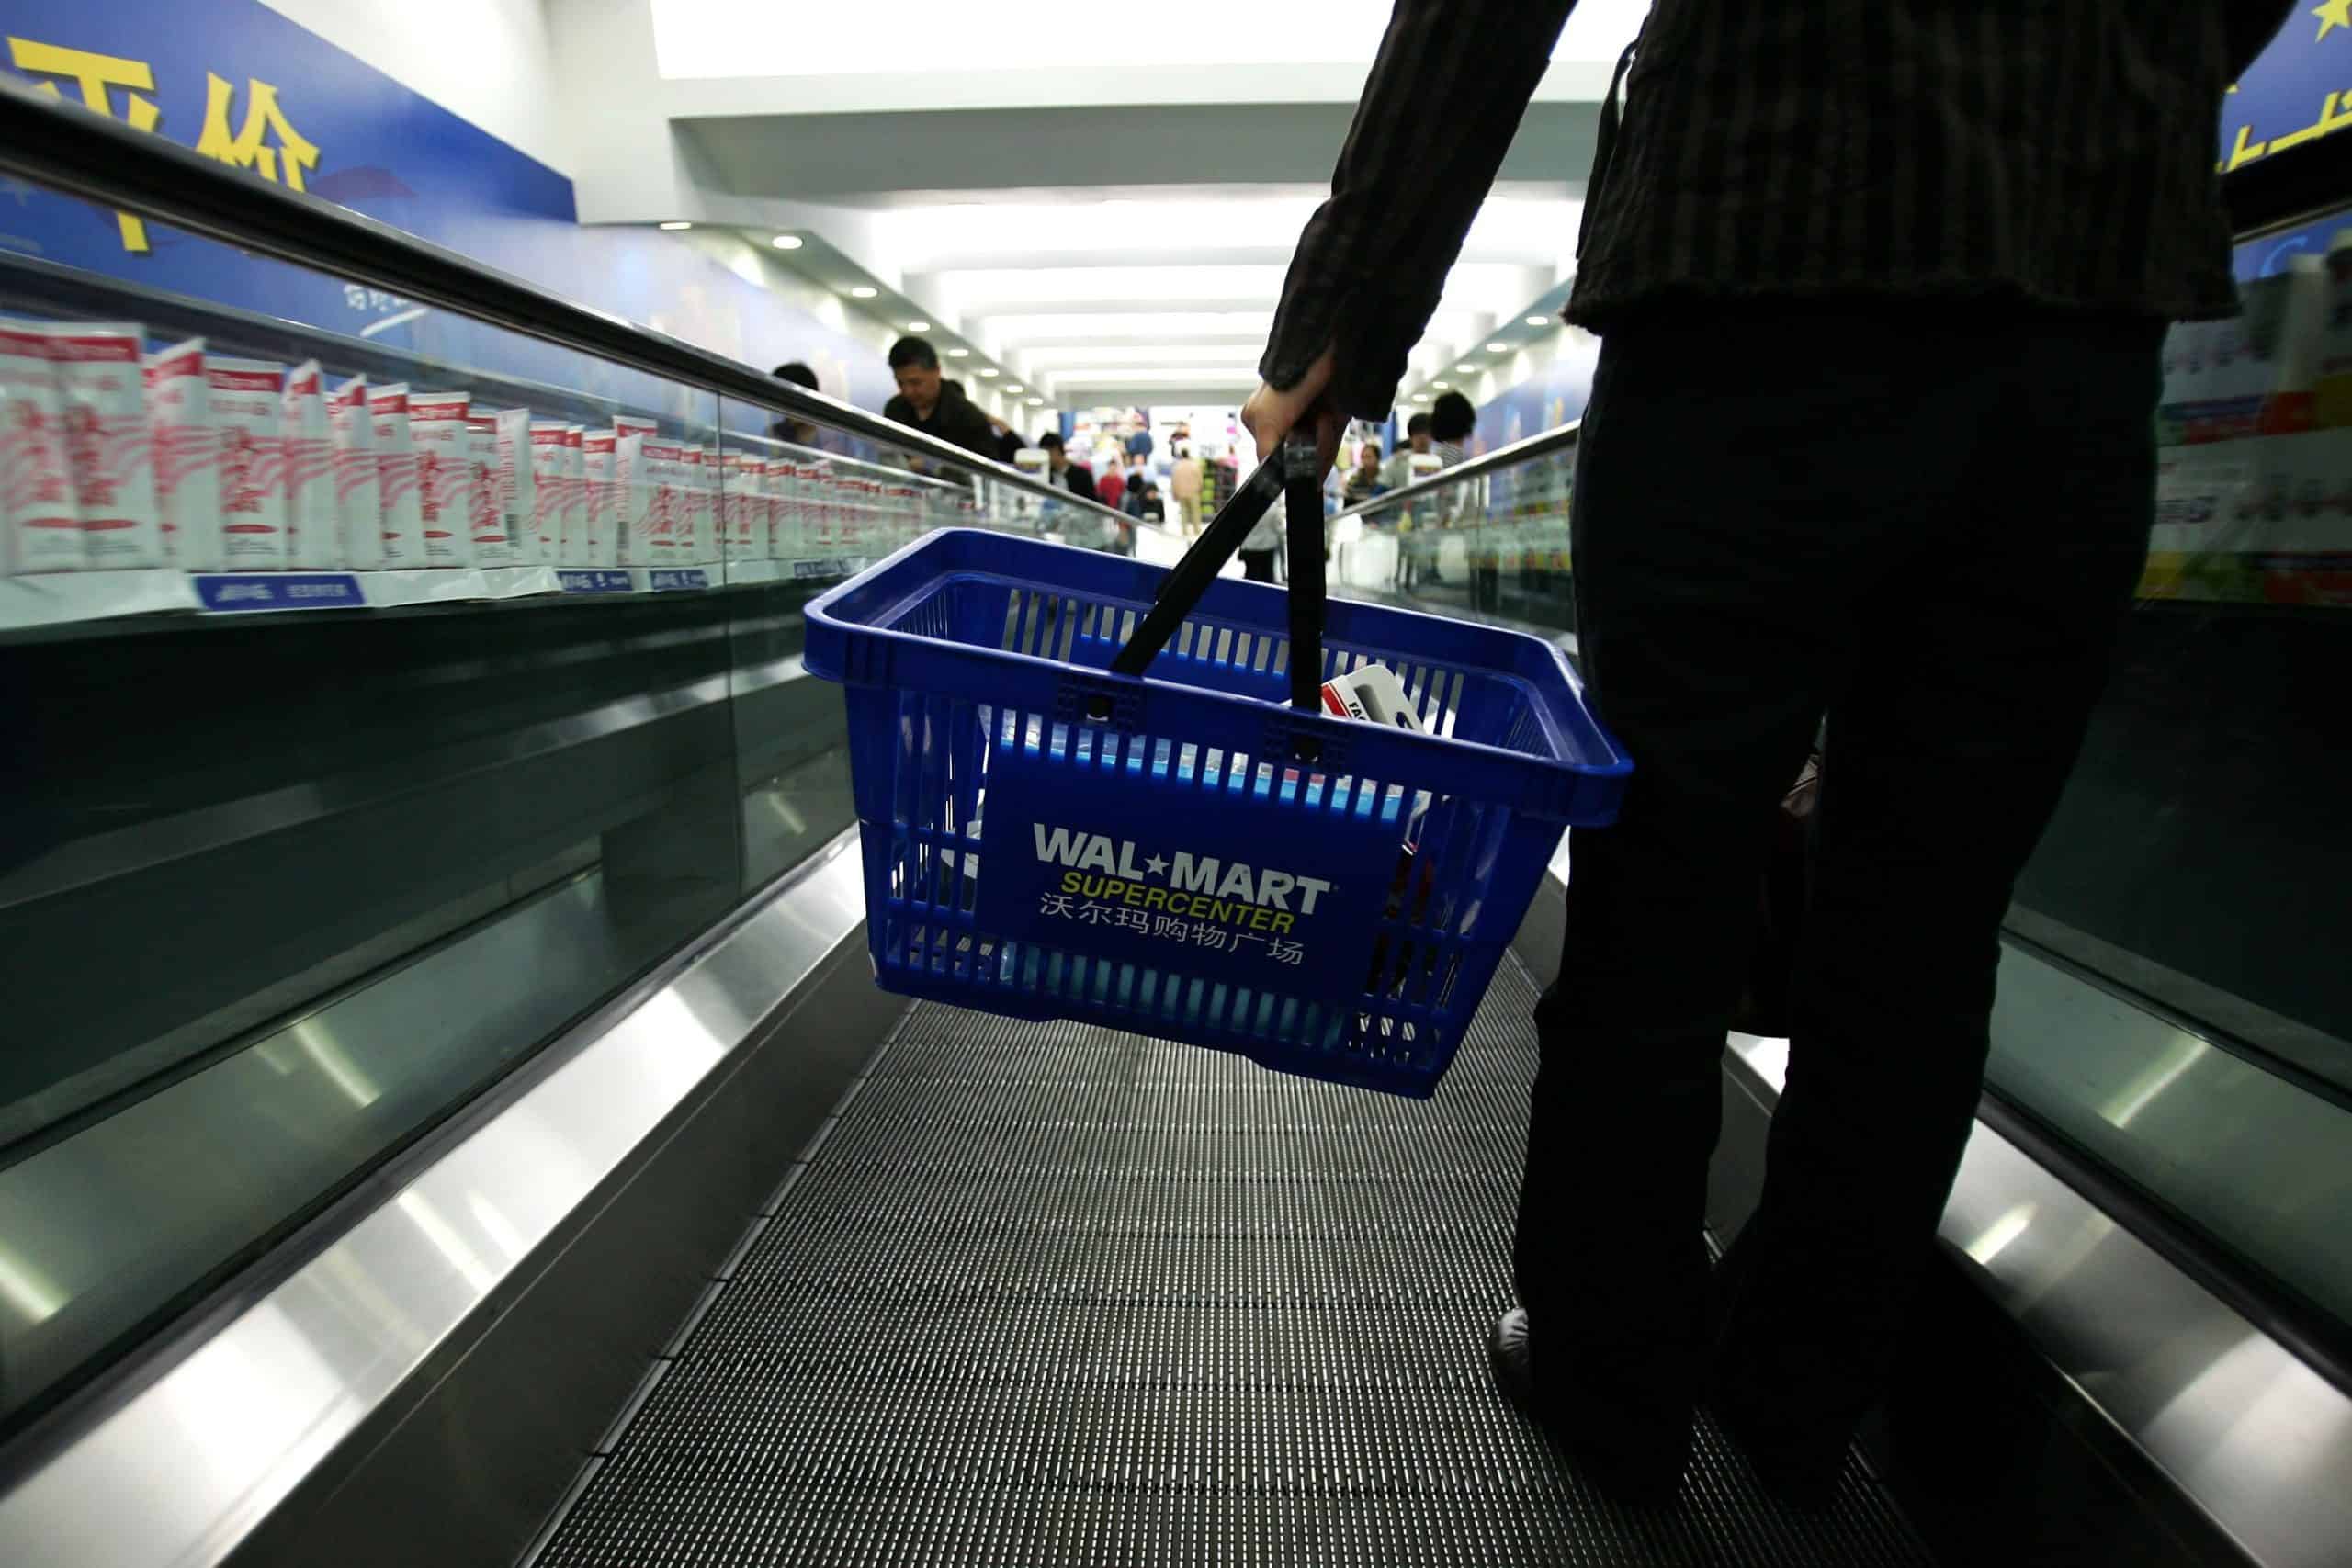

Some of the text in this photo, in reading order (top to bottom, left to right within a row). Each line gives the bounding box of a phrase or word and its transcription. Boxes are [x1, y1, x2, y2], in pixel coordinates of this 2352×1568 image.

[1039, 890, 1304, 965] 沃尔玛购物广场
[1060, 872, 1295, 934] SUPERCENTER
